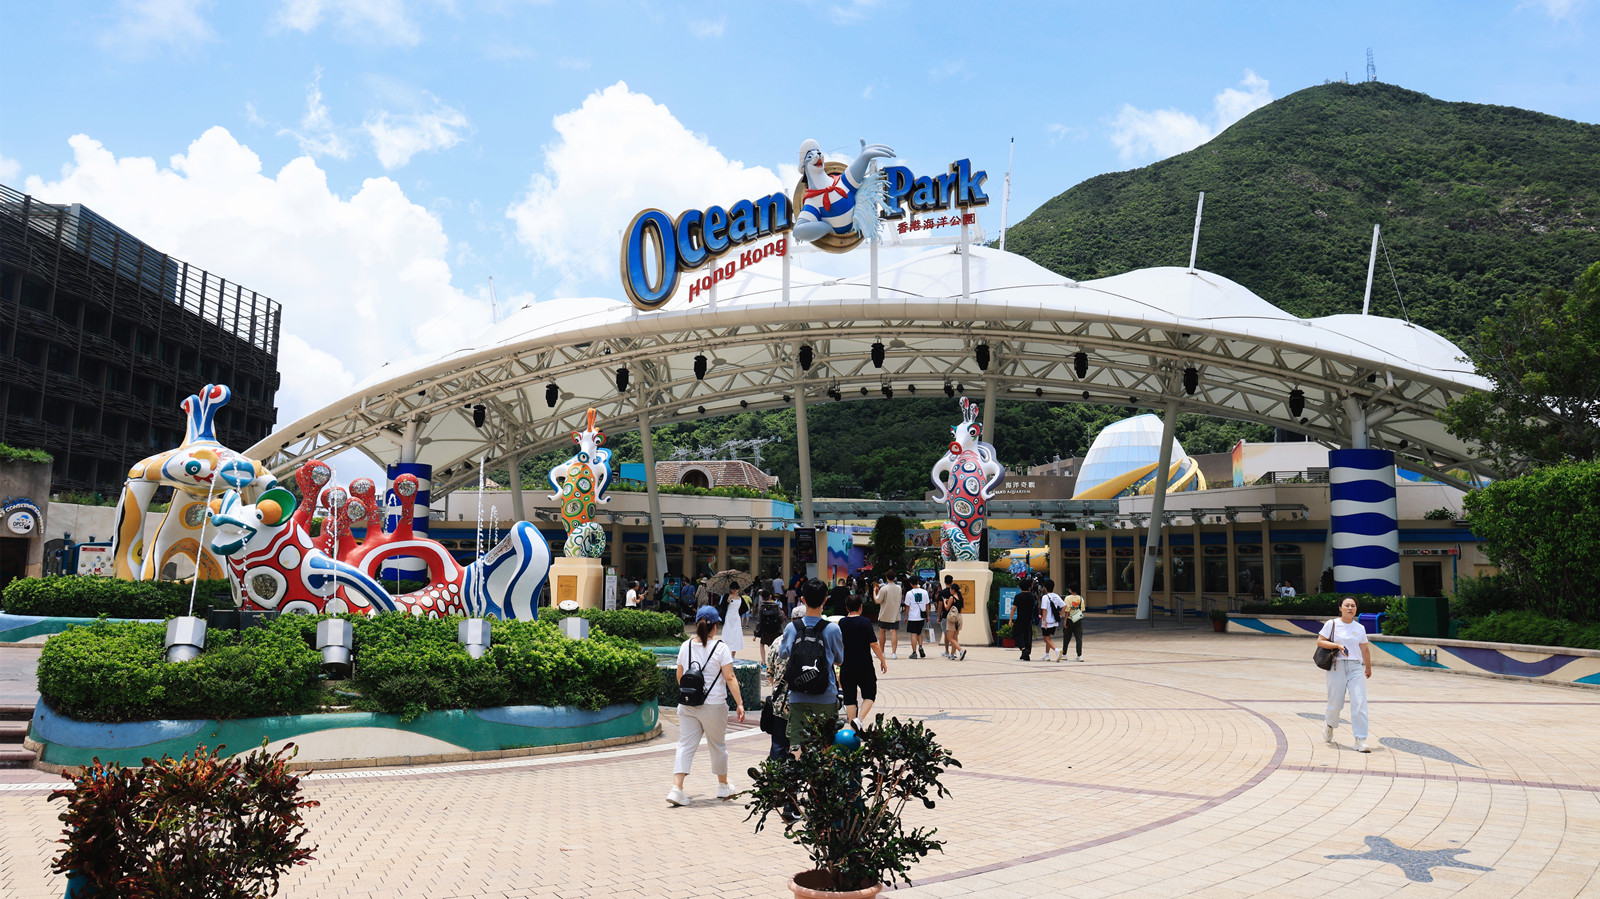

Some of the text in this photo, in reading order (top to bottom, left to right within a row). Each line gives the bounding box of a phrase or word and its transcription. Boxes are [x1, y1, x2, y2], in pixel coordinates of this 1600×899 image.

[621, 158, 988, 311] Ocean Park
[897, 213, 976, 235] 香港海洋公園
[689, 238, 787, 303] Hong Kong
